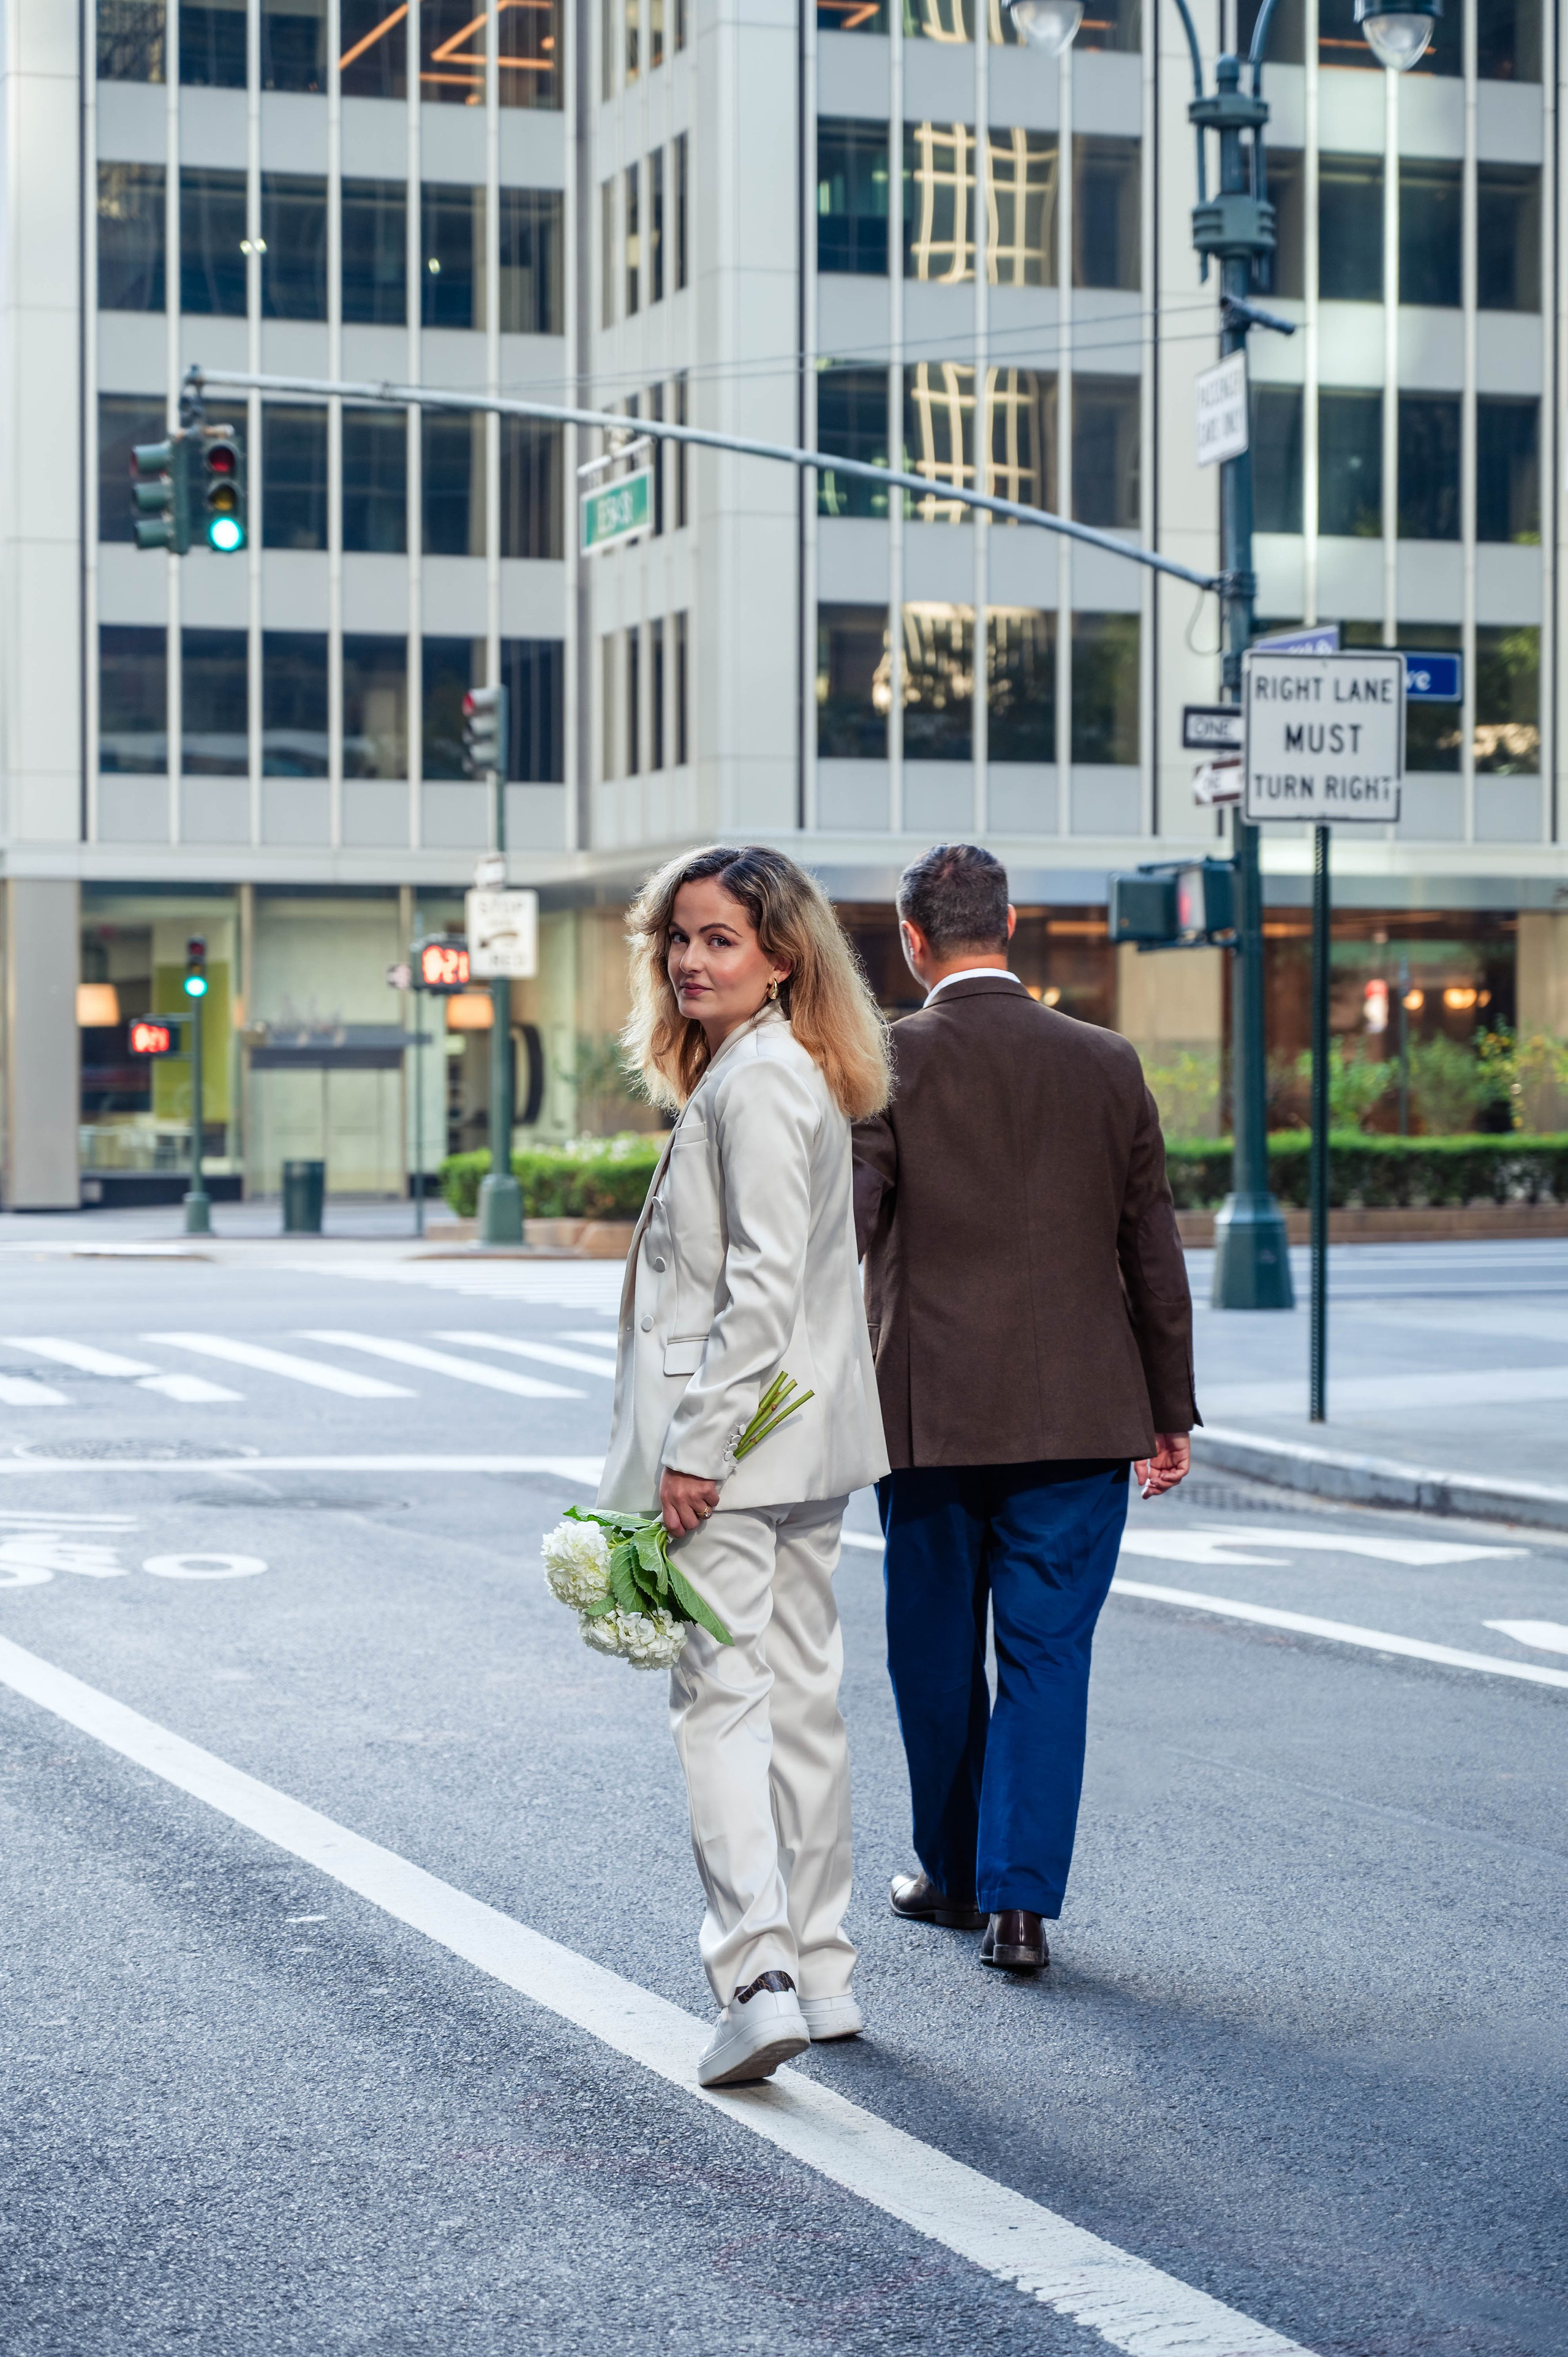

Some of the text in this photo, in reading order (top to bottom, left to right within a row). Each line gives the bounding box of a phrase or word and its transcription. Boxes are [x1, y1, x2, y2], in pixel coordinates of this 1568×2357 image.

[1256, 676, 1392, 703] RIGHT LANE
[1404, 670, 1431, 691] ve
[1284, 723, 1362, 754] MUST
[1254, 774, 1392, 801] TURN RIGHT
